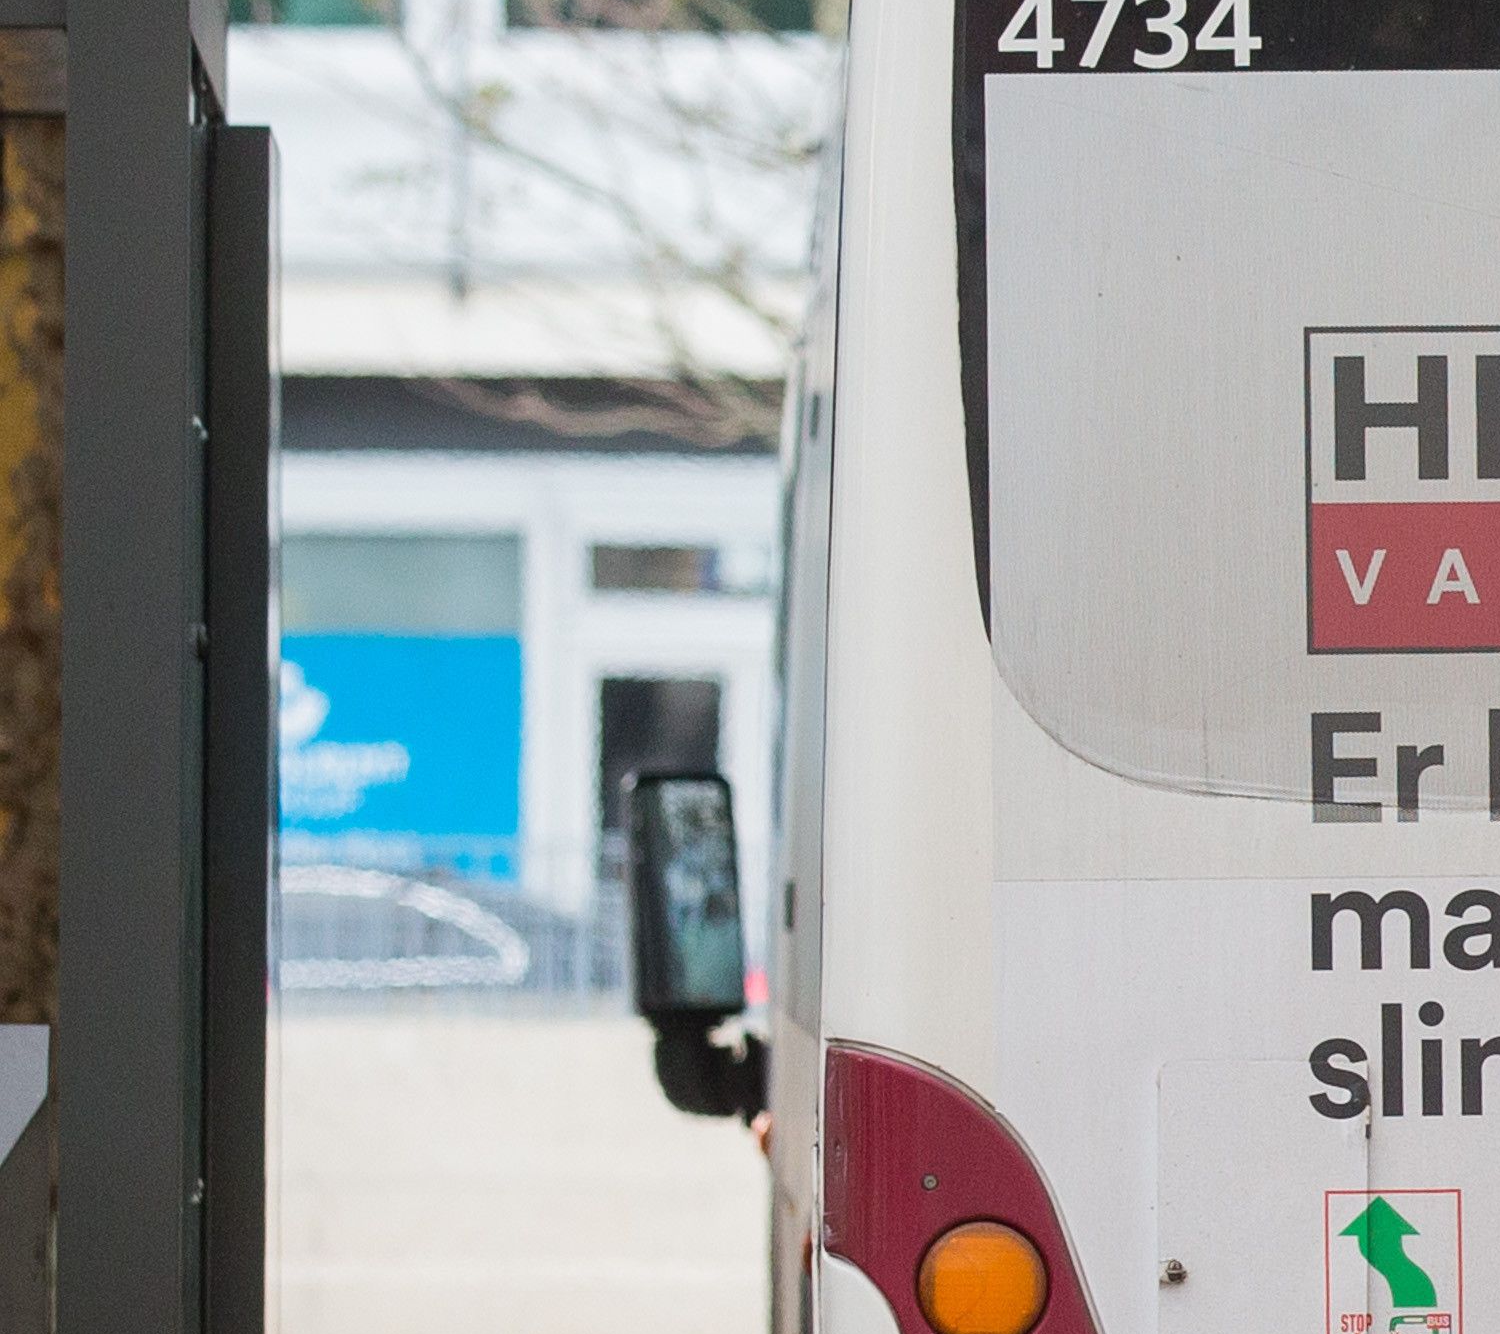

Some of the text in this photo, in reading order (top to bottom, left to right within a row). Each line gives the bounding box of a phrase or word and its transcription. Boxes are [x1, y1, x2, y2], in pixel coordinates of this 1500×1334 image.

[1308, 711, 1447, 824] Er
[1340, 1314, 1373, 1334] STOP
[1427, 1316, 1450, 1327] BUS
